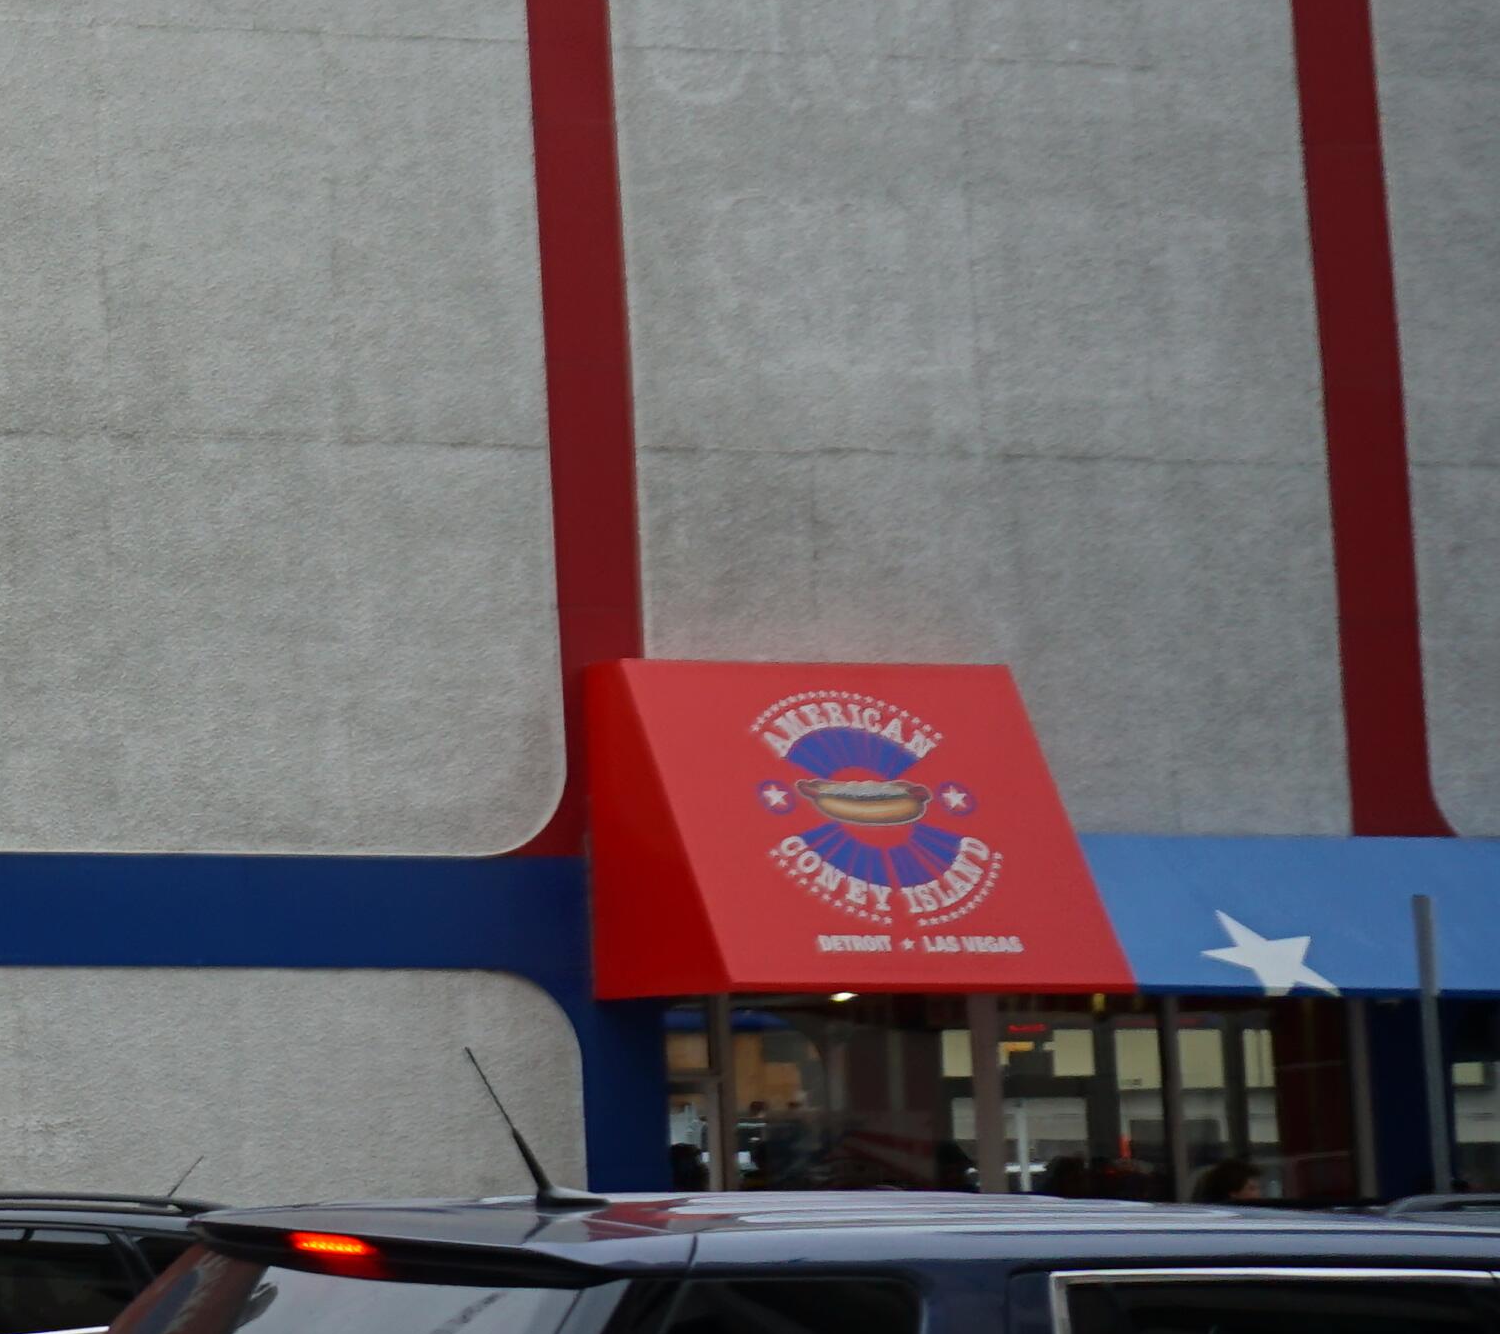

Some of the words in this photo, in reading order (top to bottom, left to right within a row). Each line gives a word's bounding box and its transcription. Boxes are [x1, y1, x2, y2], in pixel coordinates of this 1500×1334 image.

[763, 701, 937, 759] AMERICAN
[780, 835, 892, 912] CONEY
[900, 836, 989, 913] ISLAND
[817, 934, 893, 952] DETROIT
[923, 935, 960, 952] LAS
[961, 935, 1024, 953] VEGAS
